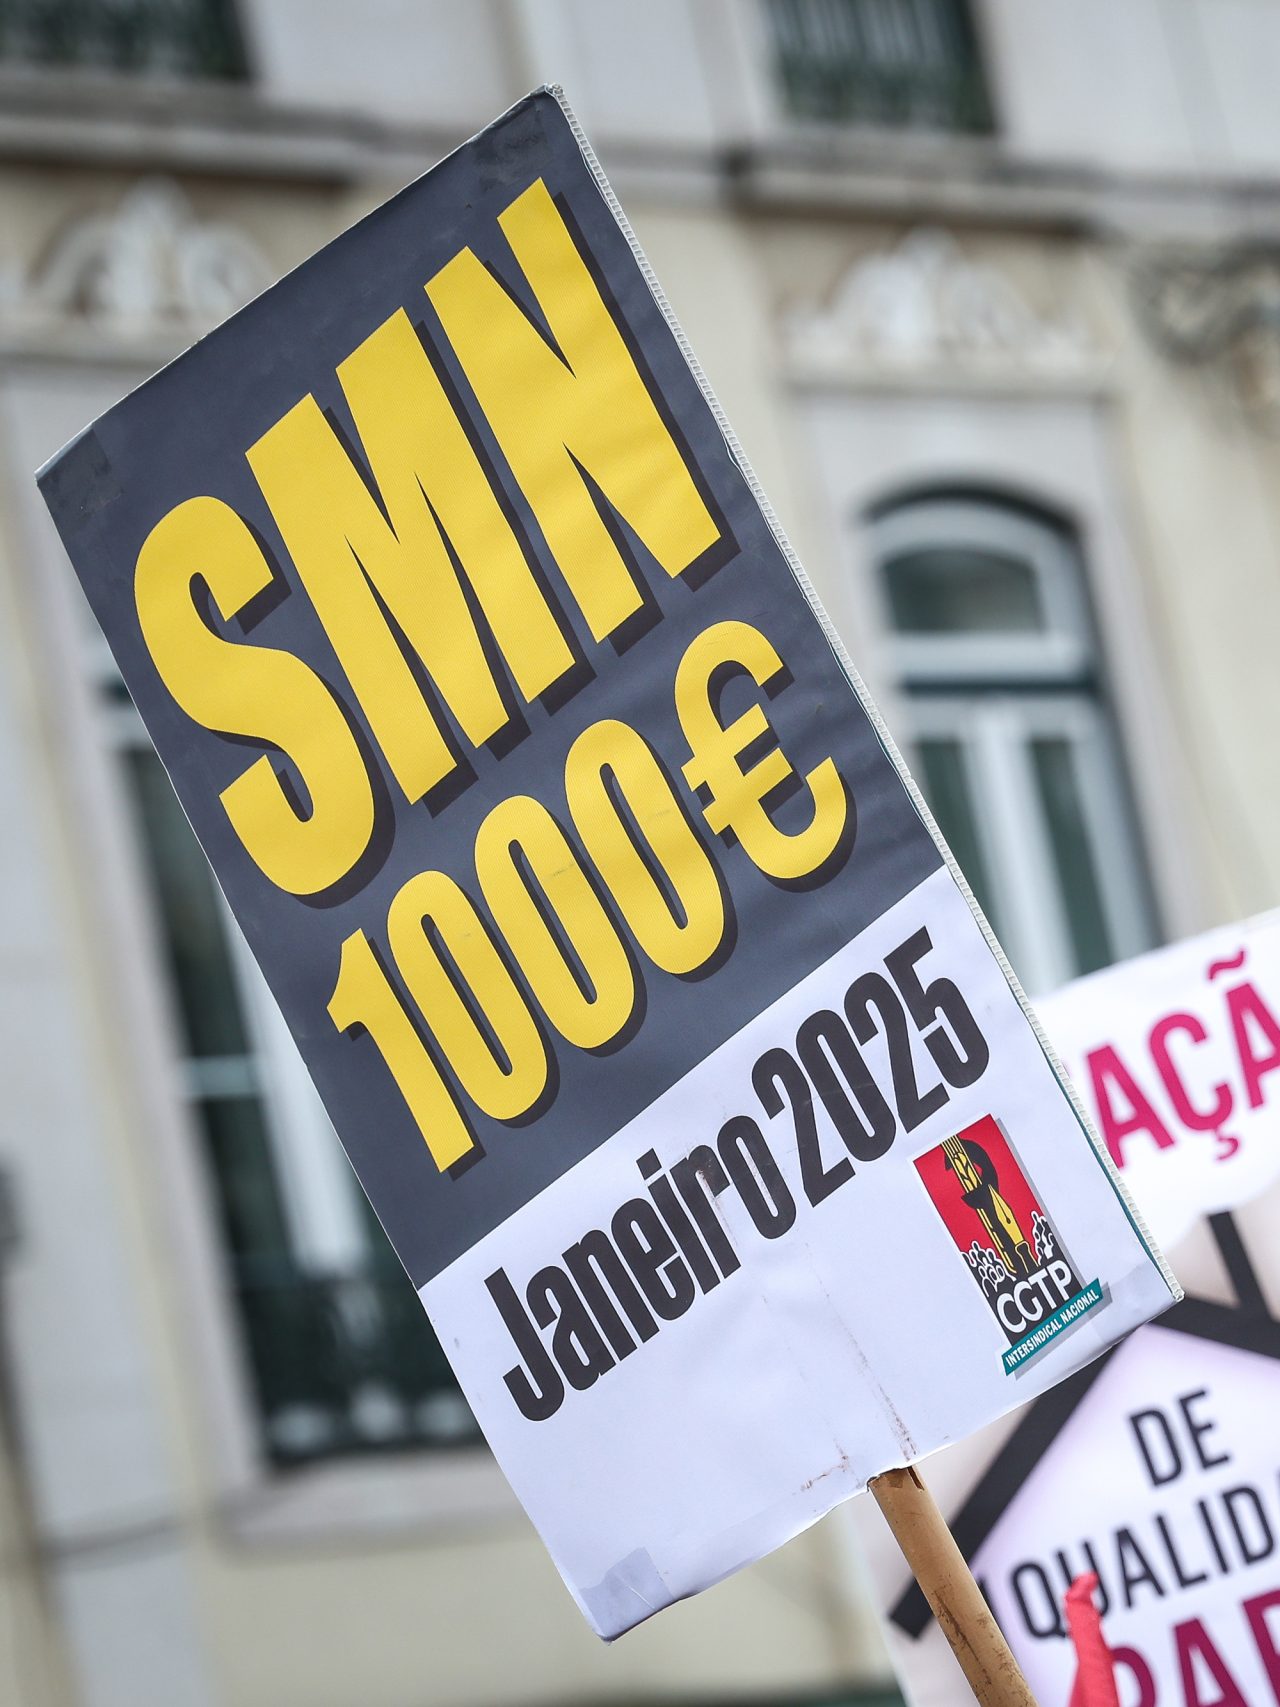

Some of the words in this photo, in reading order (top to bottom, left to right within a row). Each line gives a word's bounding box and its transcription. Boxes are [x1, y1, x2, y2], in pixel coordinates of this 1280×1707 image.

[134, 177, 721, 896] SMN
[327, 620, 847, 1173] 1000€
[484, 1116, 797, 1422] Janeiro
[751, 926, 990, 1208] 2025
[996, 1260, 1072, 1333] CGTP
[1005, 1321, 1062, 1367] INTERSINDICAL
[1060, 1289, 1100, 1324] NACIONAL
[1130, 1388, 1230, 1487] DE
